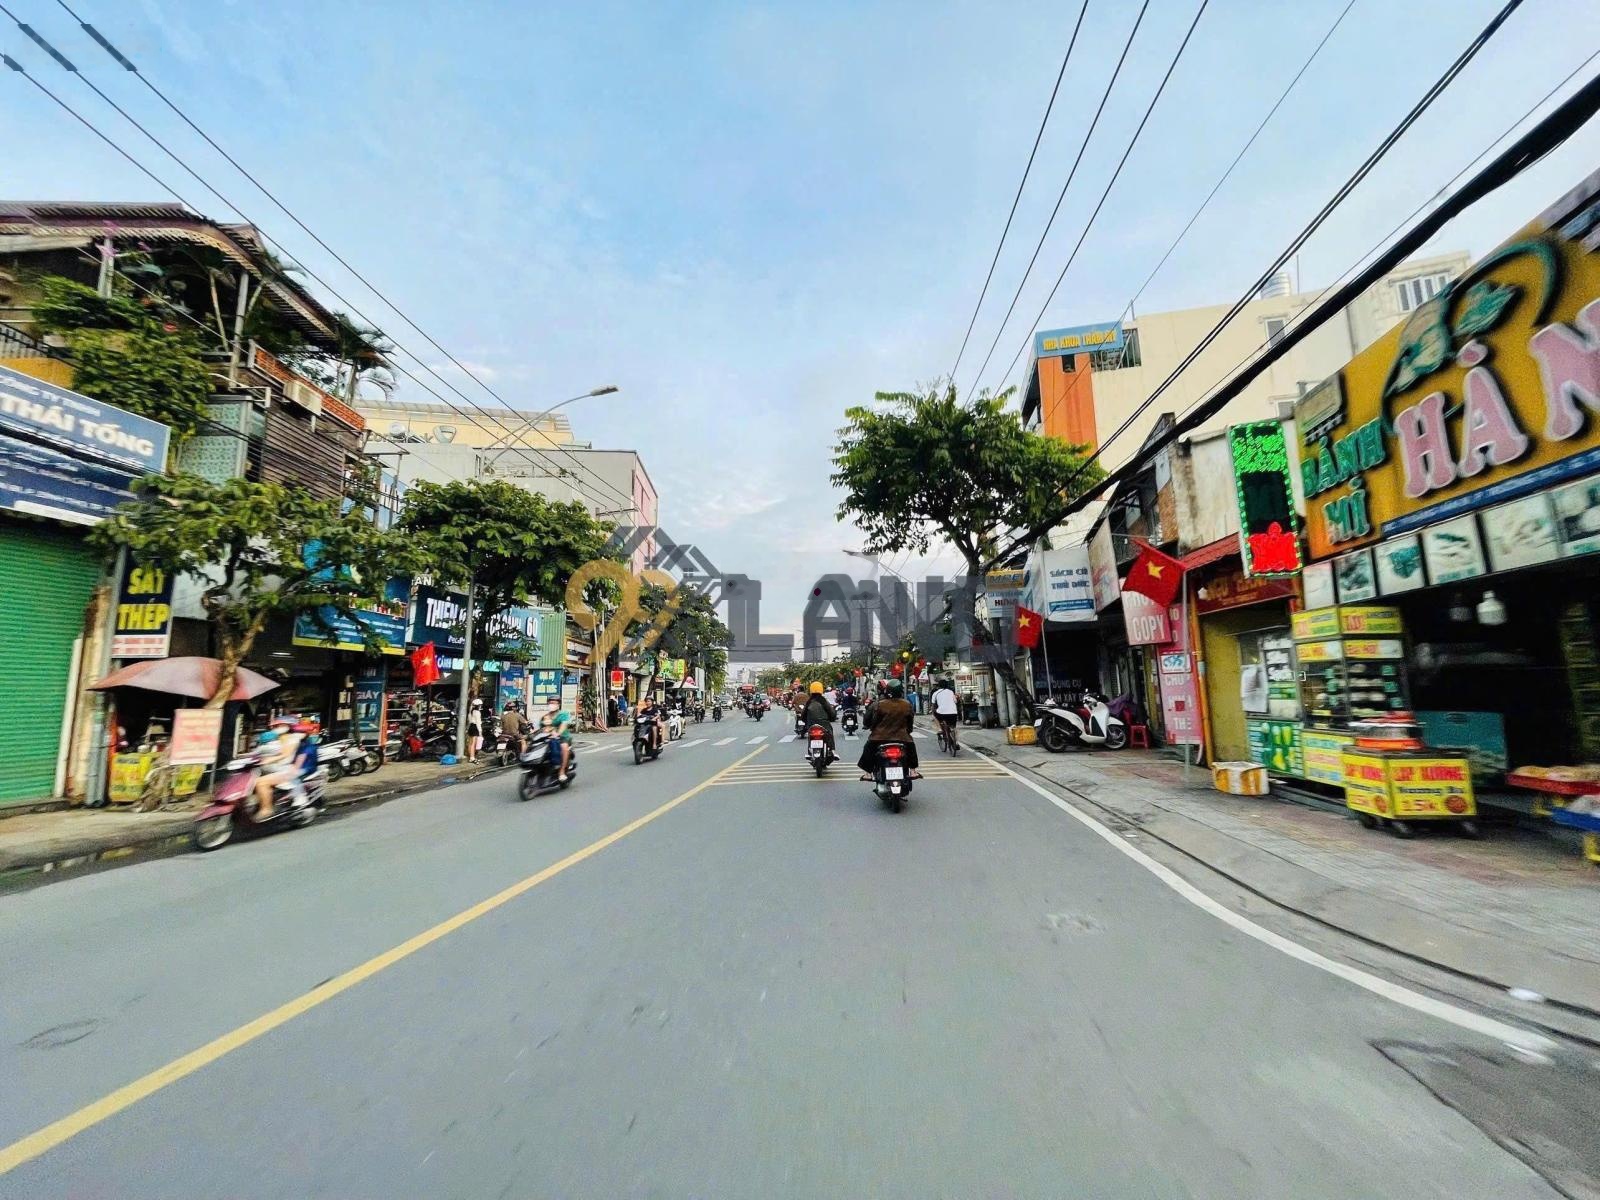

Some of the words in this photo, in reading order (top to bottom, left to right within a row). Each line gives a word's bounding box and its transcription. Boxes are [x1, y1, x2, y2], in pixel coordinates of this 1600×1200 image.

[0, 393, 75, 432] THÁI
[79, 418, 155, 458] TỐNG
[117, 597, 170, 631] THÉP
[1132, 614, 1165, 641] COPY
